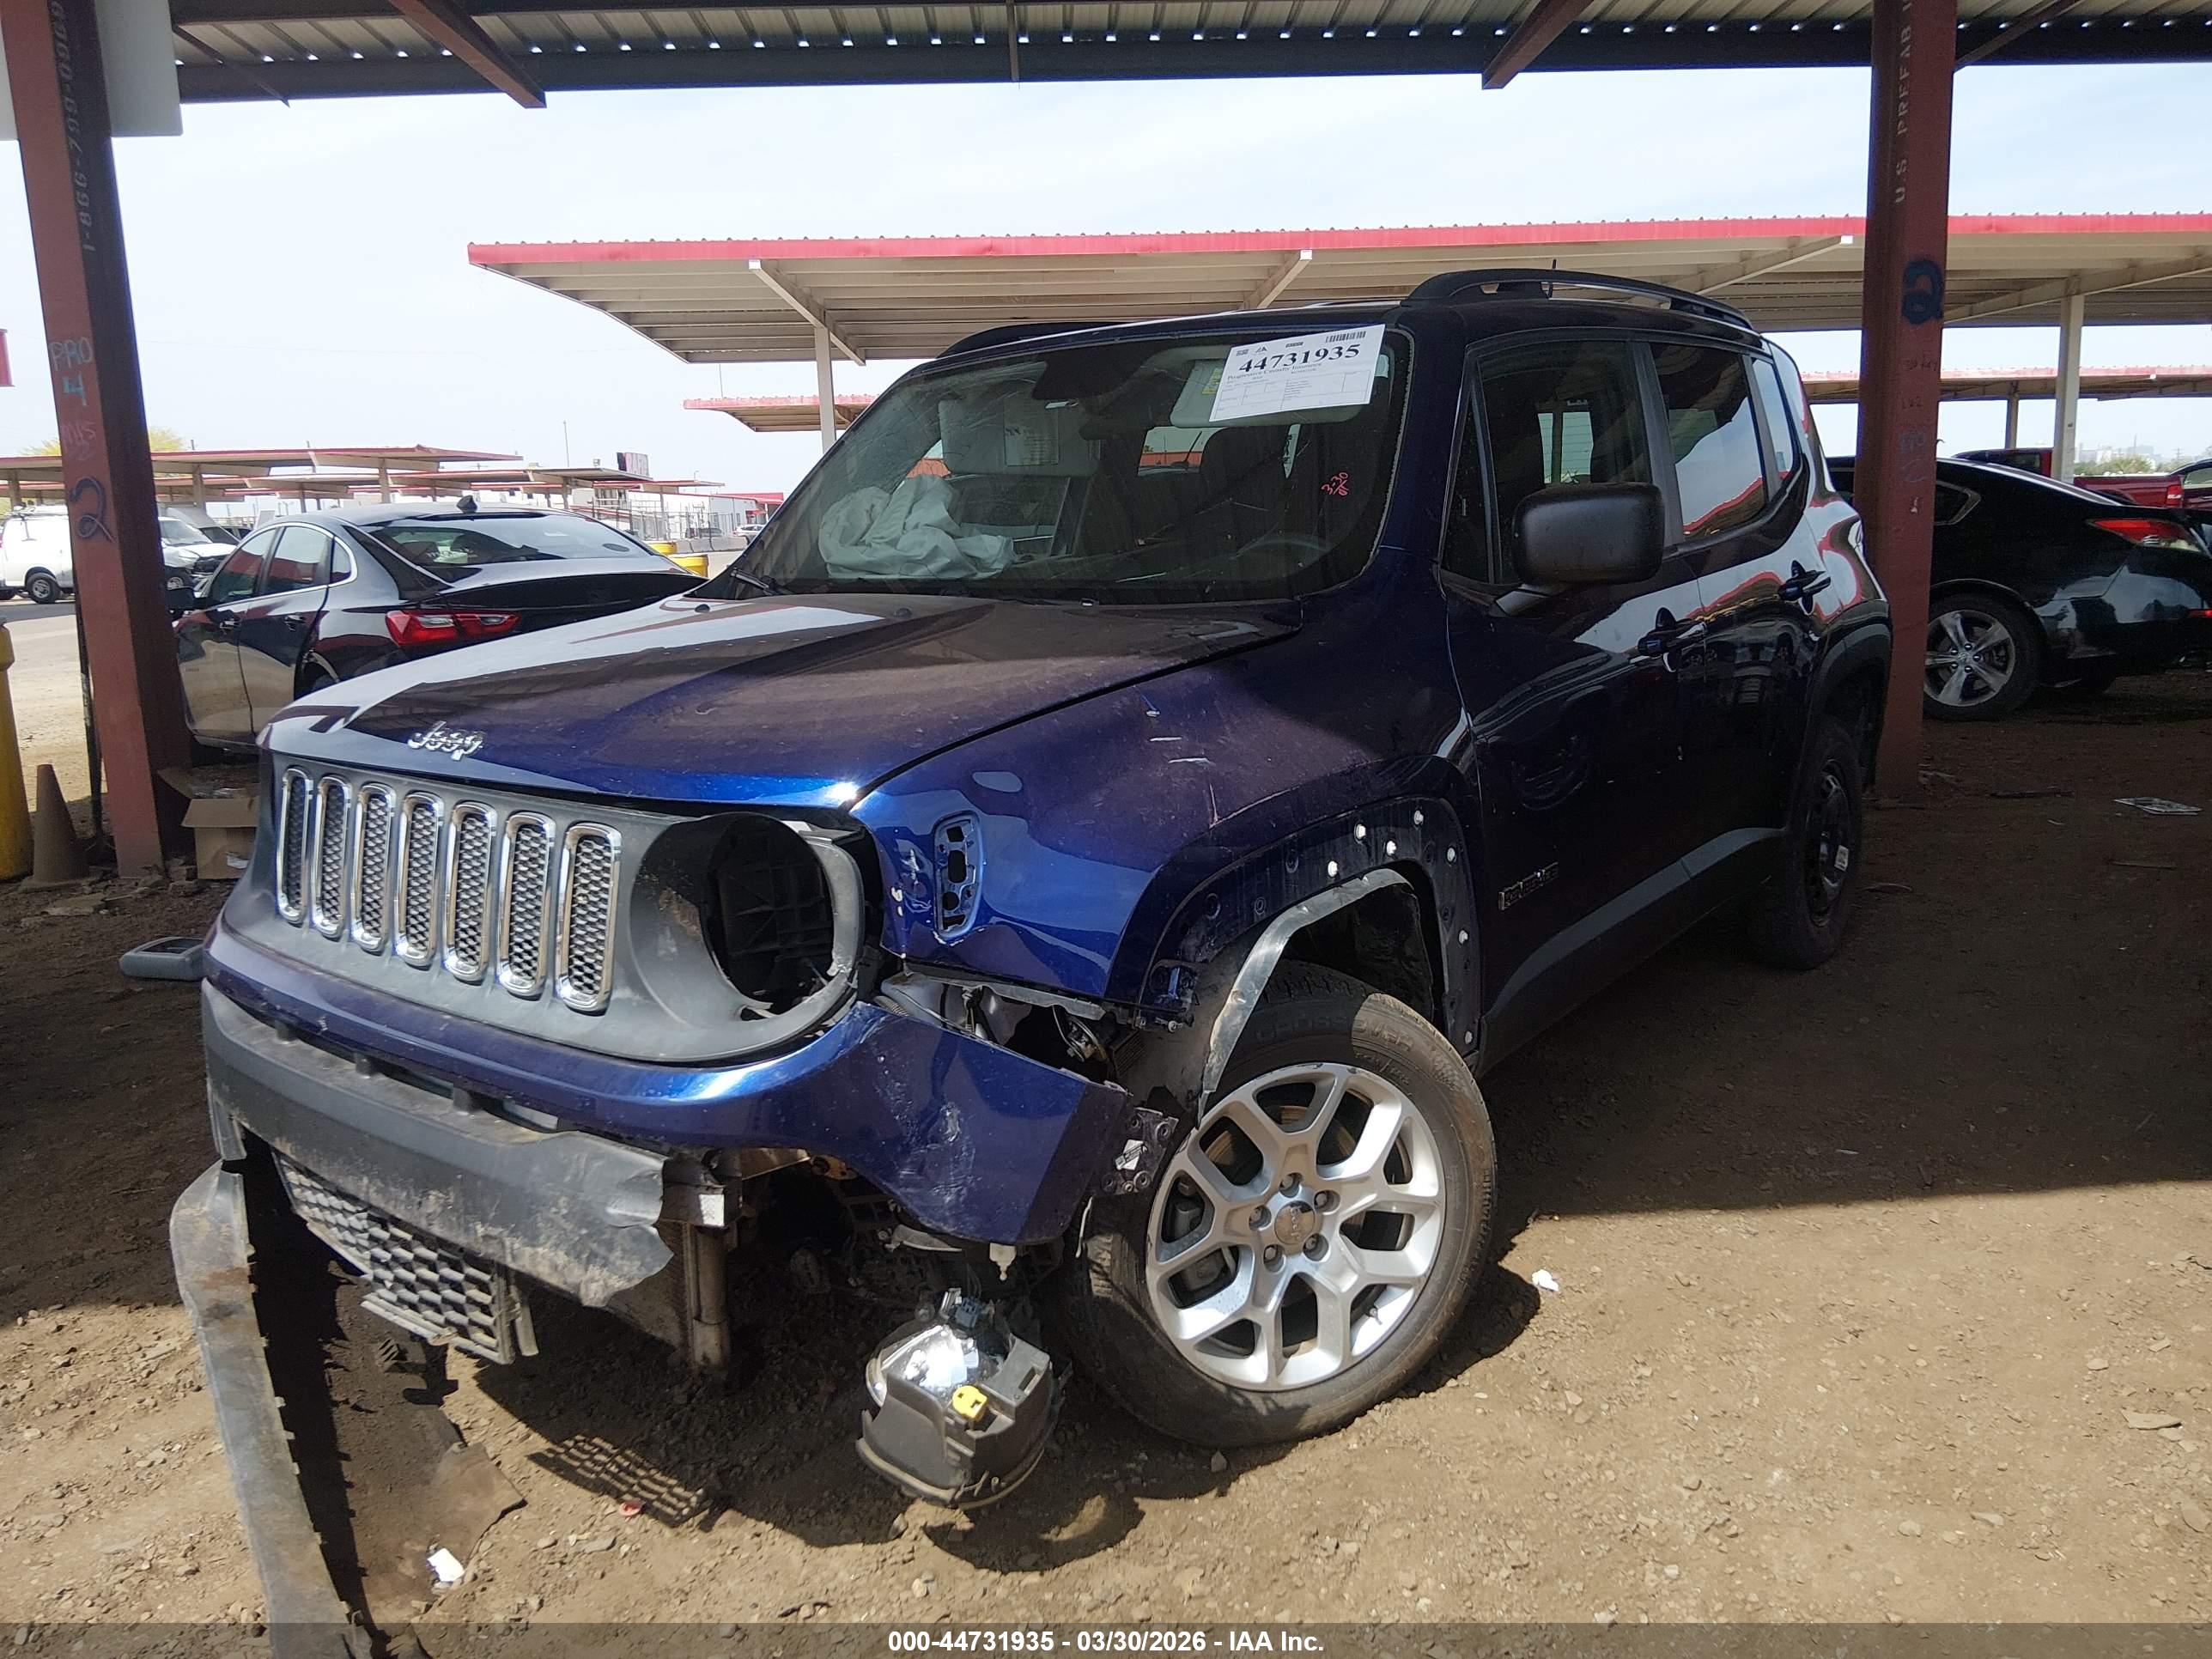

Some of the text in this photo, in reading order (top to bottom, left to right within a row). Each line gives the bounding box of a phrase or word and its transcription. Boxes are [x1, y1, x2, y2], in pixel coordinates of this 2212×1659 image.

[1897, 25, 1911, 135] PREFAB
[1239, 343, 1360, 372] 44731935
[69, 477, 117, 544] 2
[407, 720, 487, 761] Jeep
